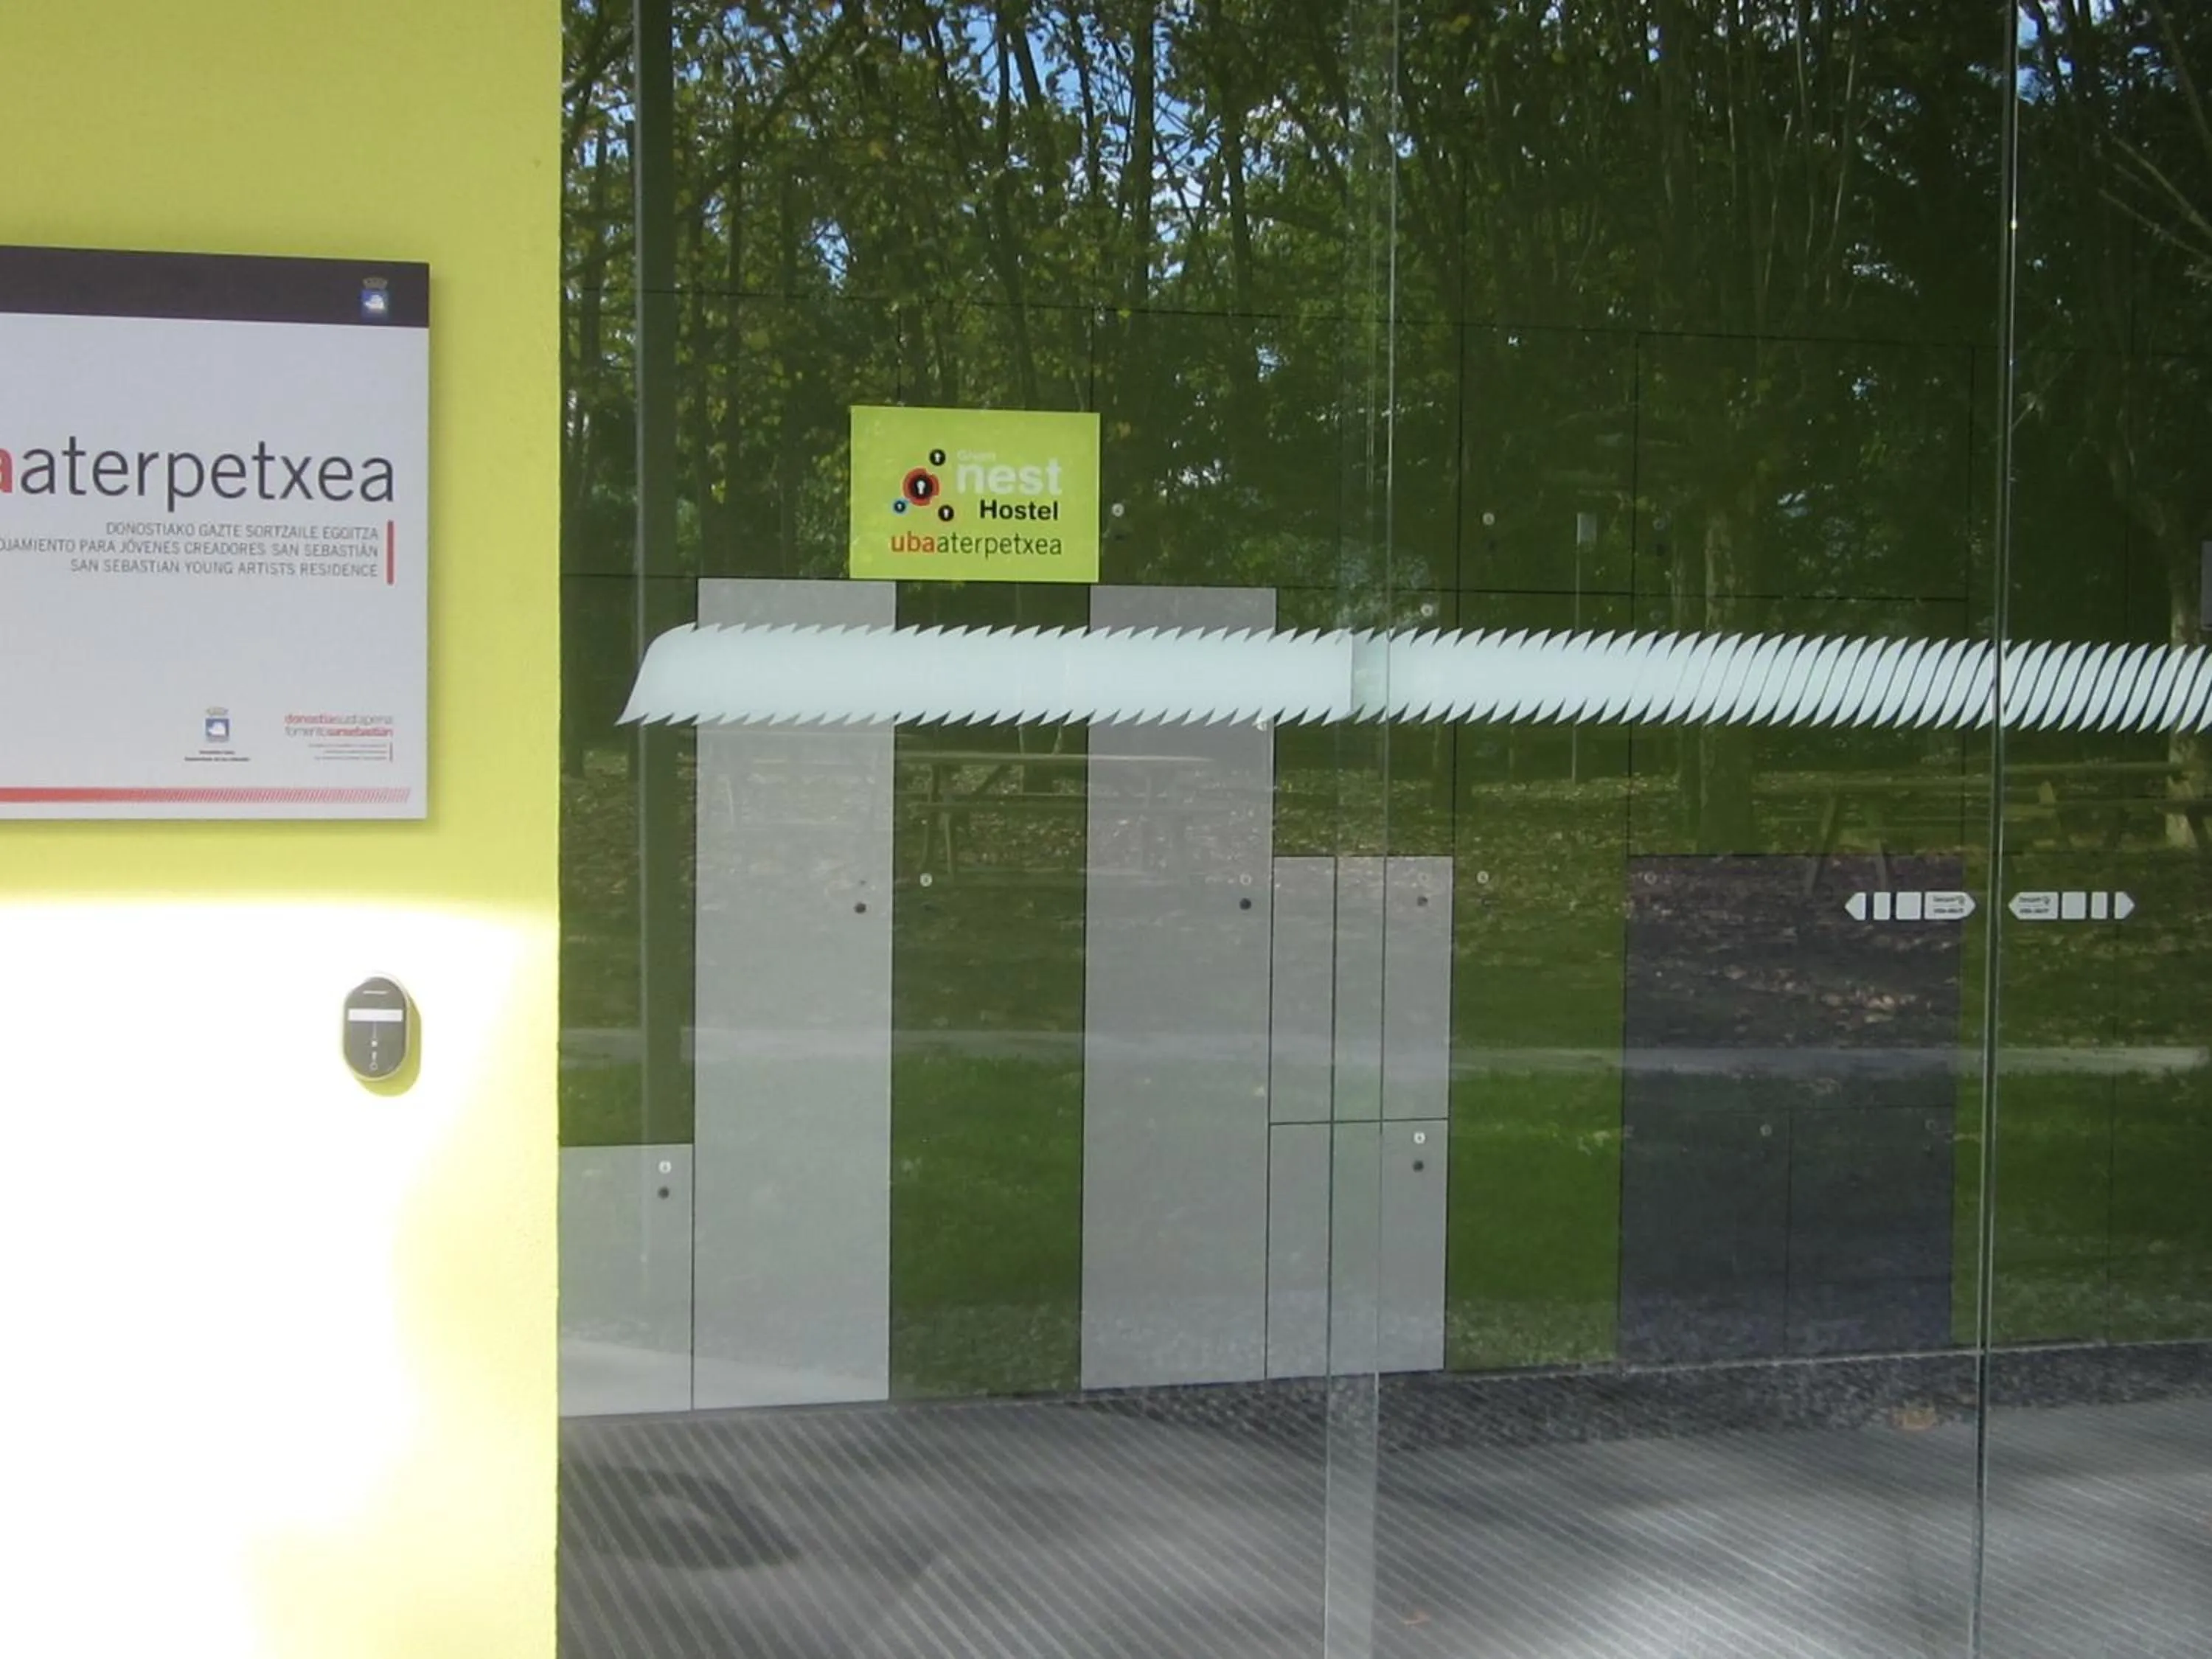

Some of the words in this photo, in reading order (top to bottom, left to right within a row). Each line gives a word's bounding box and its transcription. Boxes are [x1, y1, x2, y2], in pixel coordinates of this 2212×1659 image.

[956, 457, 1062, 496] nest
[979, 499, 1058, 521] Hostel
[105, 521, 195, 536] DONOSTIAKO
[198, 523, 242, 538] GAZTE
[246, 524, 319, 539] SORTZAILE
[80, 540, 116, 554] PARA
[119, 539, 181, 555] JÓVENES
[186, 542, 266, 556] CREADORES
[271, 543, 299, 557] SAN
[305, 542, 379, 558] SEBASTIÁN
[890, 531, 1062, 559] ubaaterpetxea
[70, 558, 99, 572] SAN
[103, 559, 180, 574] SEBASTIAN
[185, 560, 232, 575] YOUNG
[237, 562, 296, 576] ARTISTS
[299, 563, 378, 577] RESIDENCE
